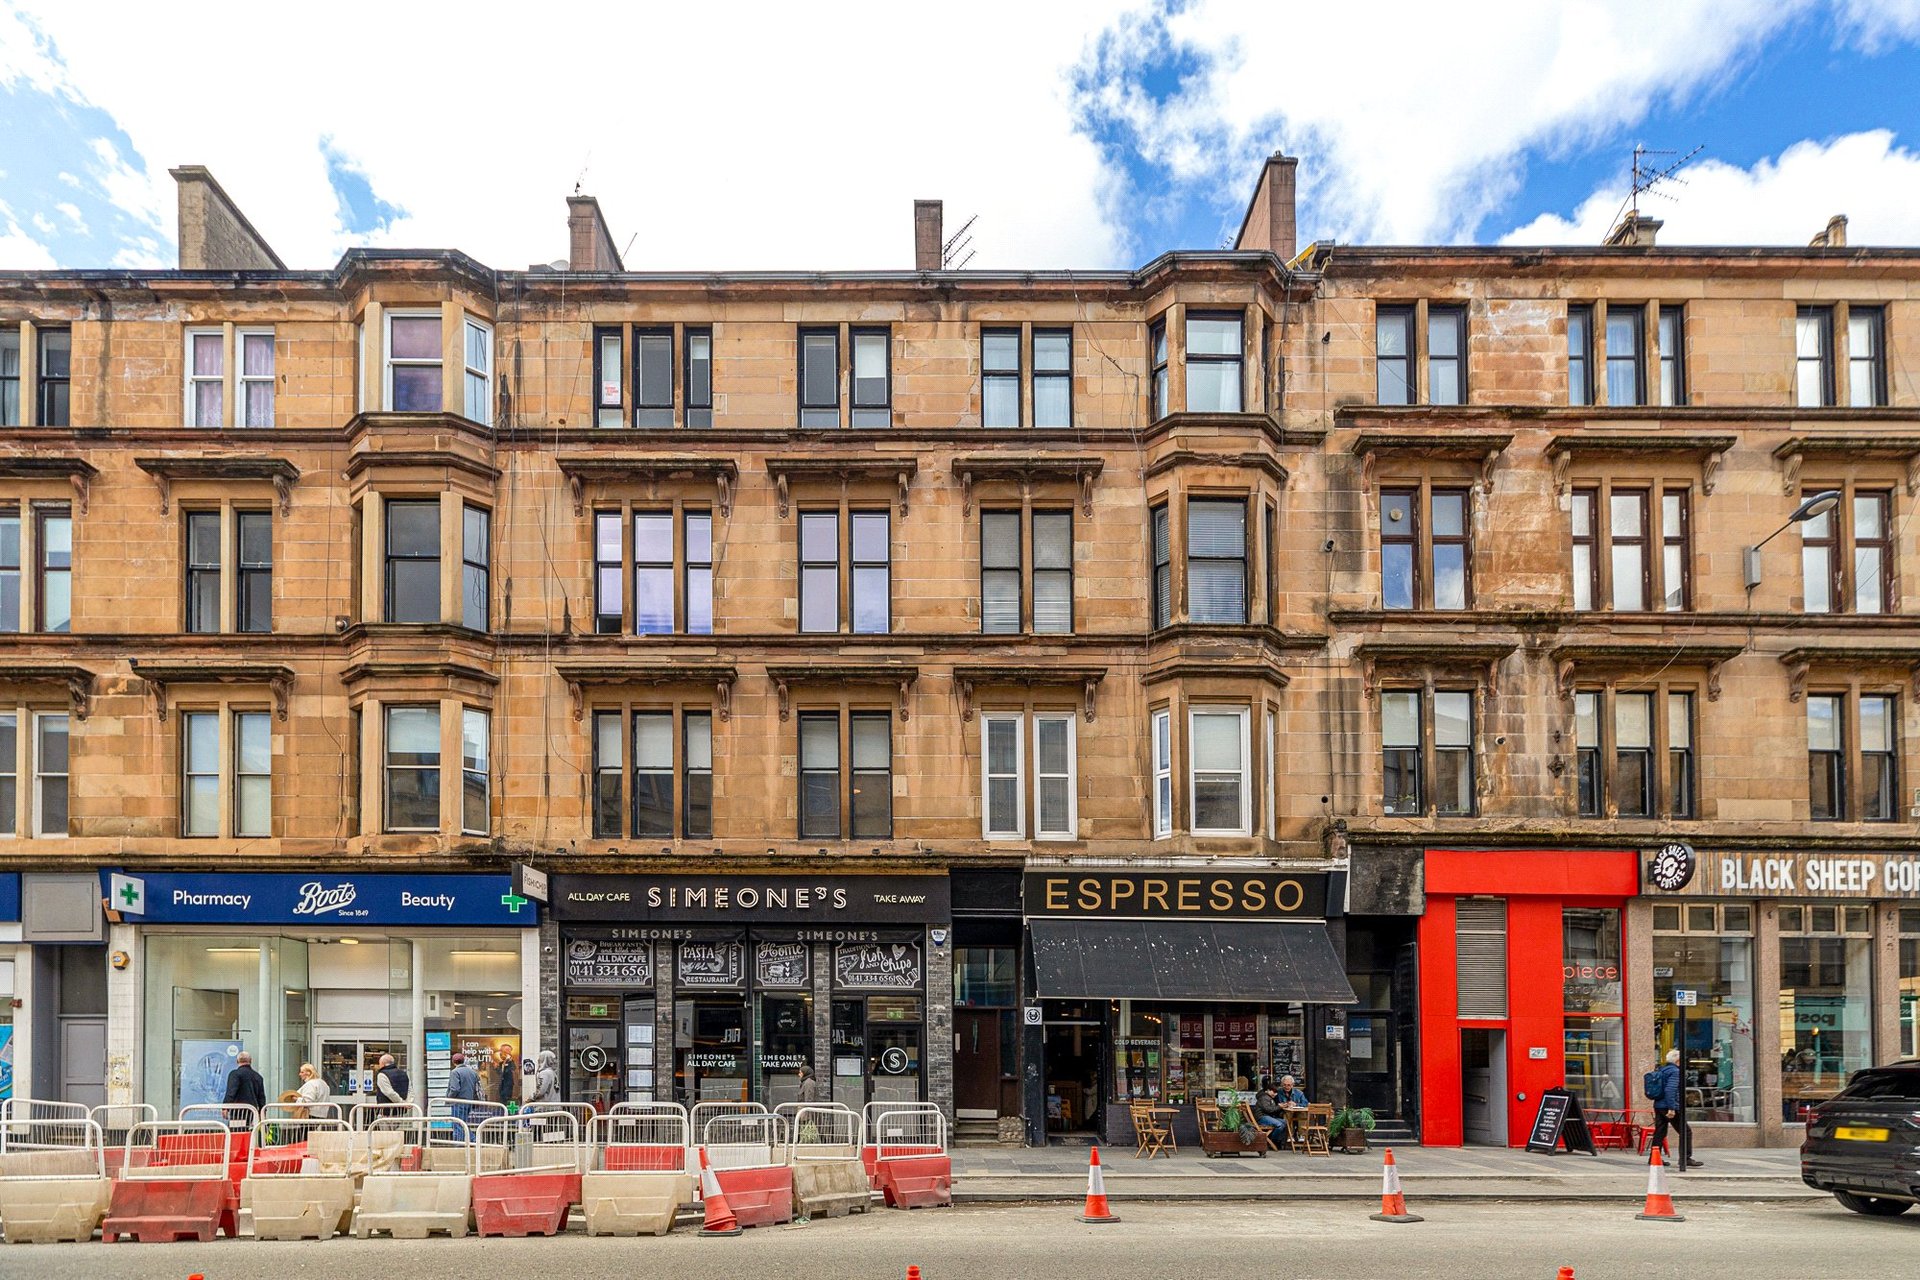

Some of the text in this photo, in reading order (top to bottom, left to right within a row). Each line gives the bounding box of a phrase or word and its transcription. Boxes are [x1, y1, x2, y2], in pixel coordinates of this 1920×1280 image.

[1654, 844, 1687, 875] BLACK SHEEP
[1660, 869, 1686, 889] COFFEE
[1721, 858, 1795, 890] BLACK
[1805, 859, 1876, 891] SHEEP
[173, 889, 252, 910] Pharmacy
[293, 881, 357, 916] Boots
[401, 891, 456, 911] Beauty
[567, 892, 630, 902] ALL DAY CAFE
[647, 886, 847, 909] SIMEONE'S
[874, 894, 926, 904] TAKE AWAY
[1046, 878, 1304, 911] ESPRESSO
[338, 909, 369, 917] Since 1849
[611, 928, 693, 939] SIMEONE'S
[797, 931, 878, 941] SIMEONE'S
[683, 946, 715, 959] PASTA
[759, 942, 805, 959] Home
[597, 955, 647, 963] ALL DAY CAFE
[570, 965, 649, 976] 0141 334 6561
[1562, 961, 1618, 984] piece
[462, 1047, 477, 1056] help
[464, 1054, 478, 1062] hat
[1531, 1048, 1546, 1058] 297
[588, 1051, 599, 1067] S
[687, 1060, 737, 1068] ALL DAY CAFE
[780, 1061, 803, 1069] AWAY
[889, 1052, 901, 1069] S
